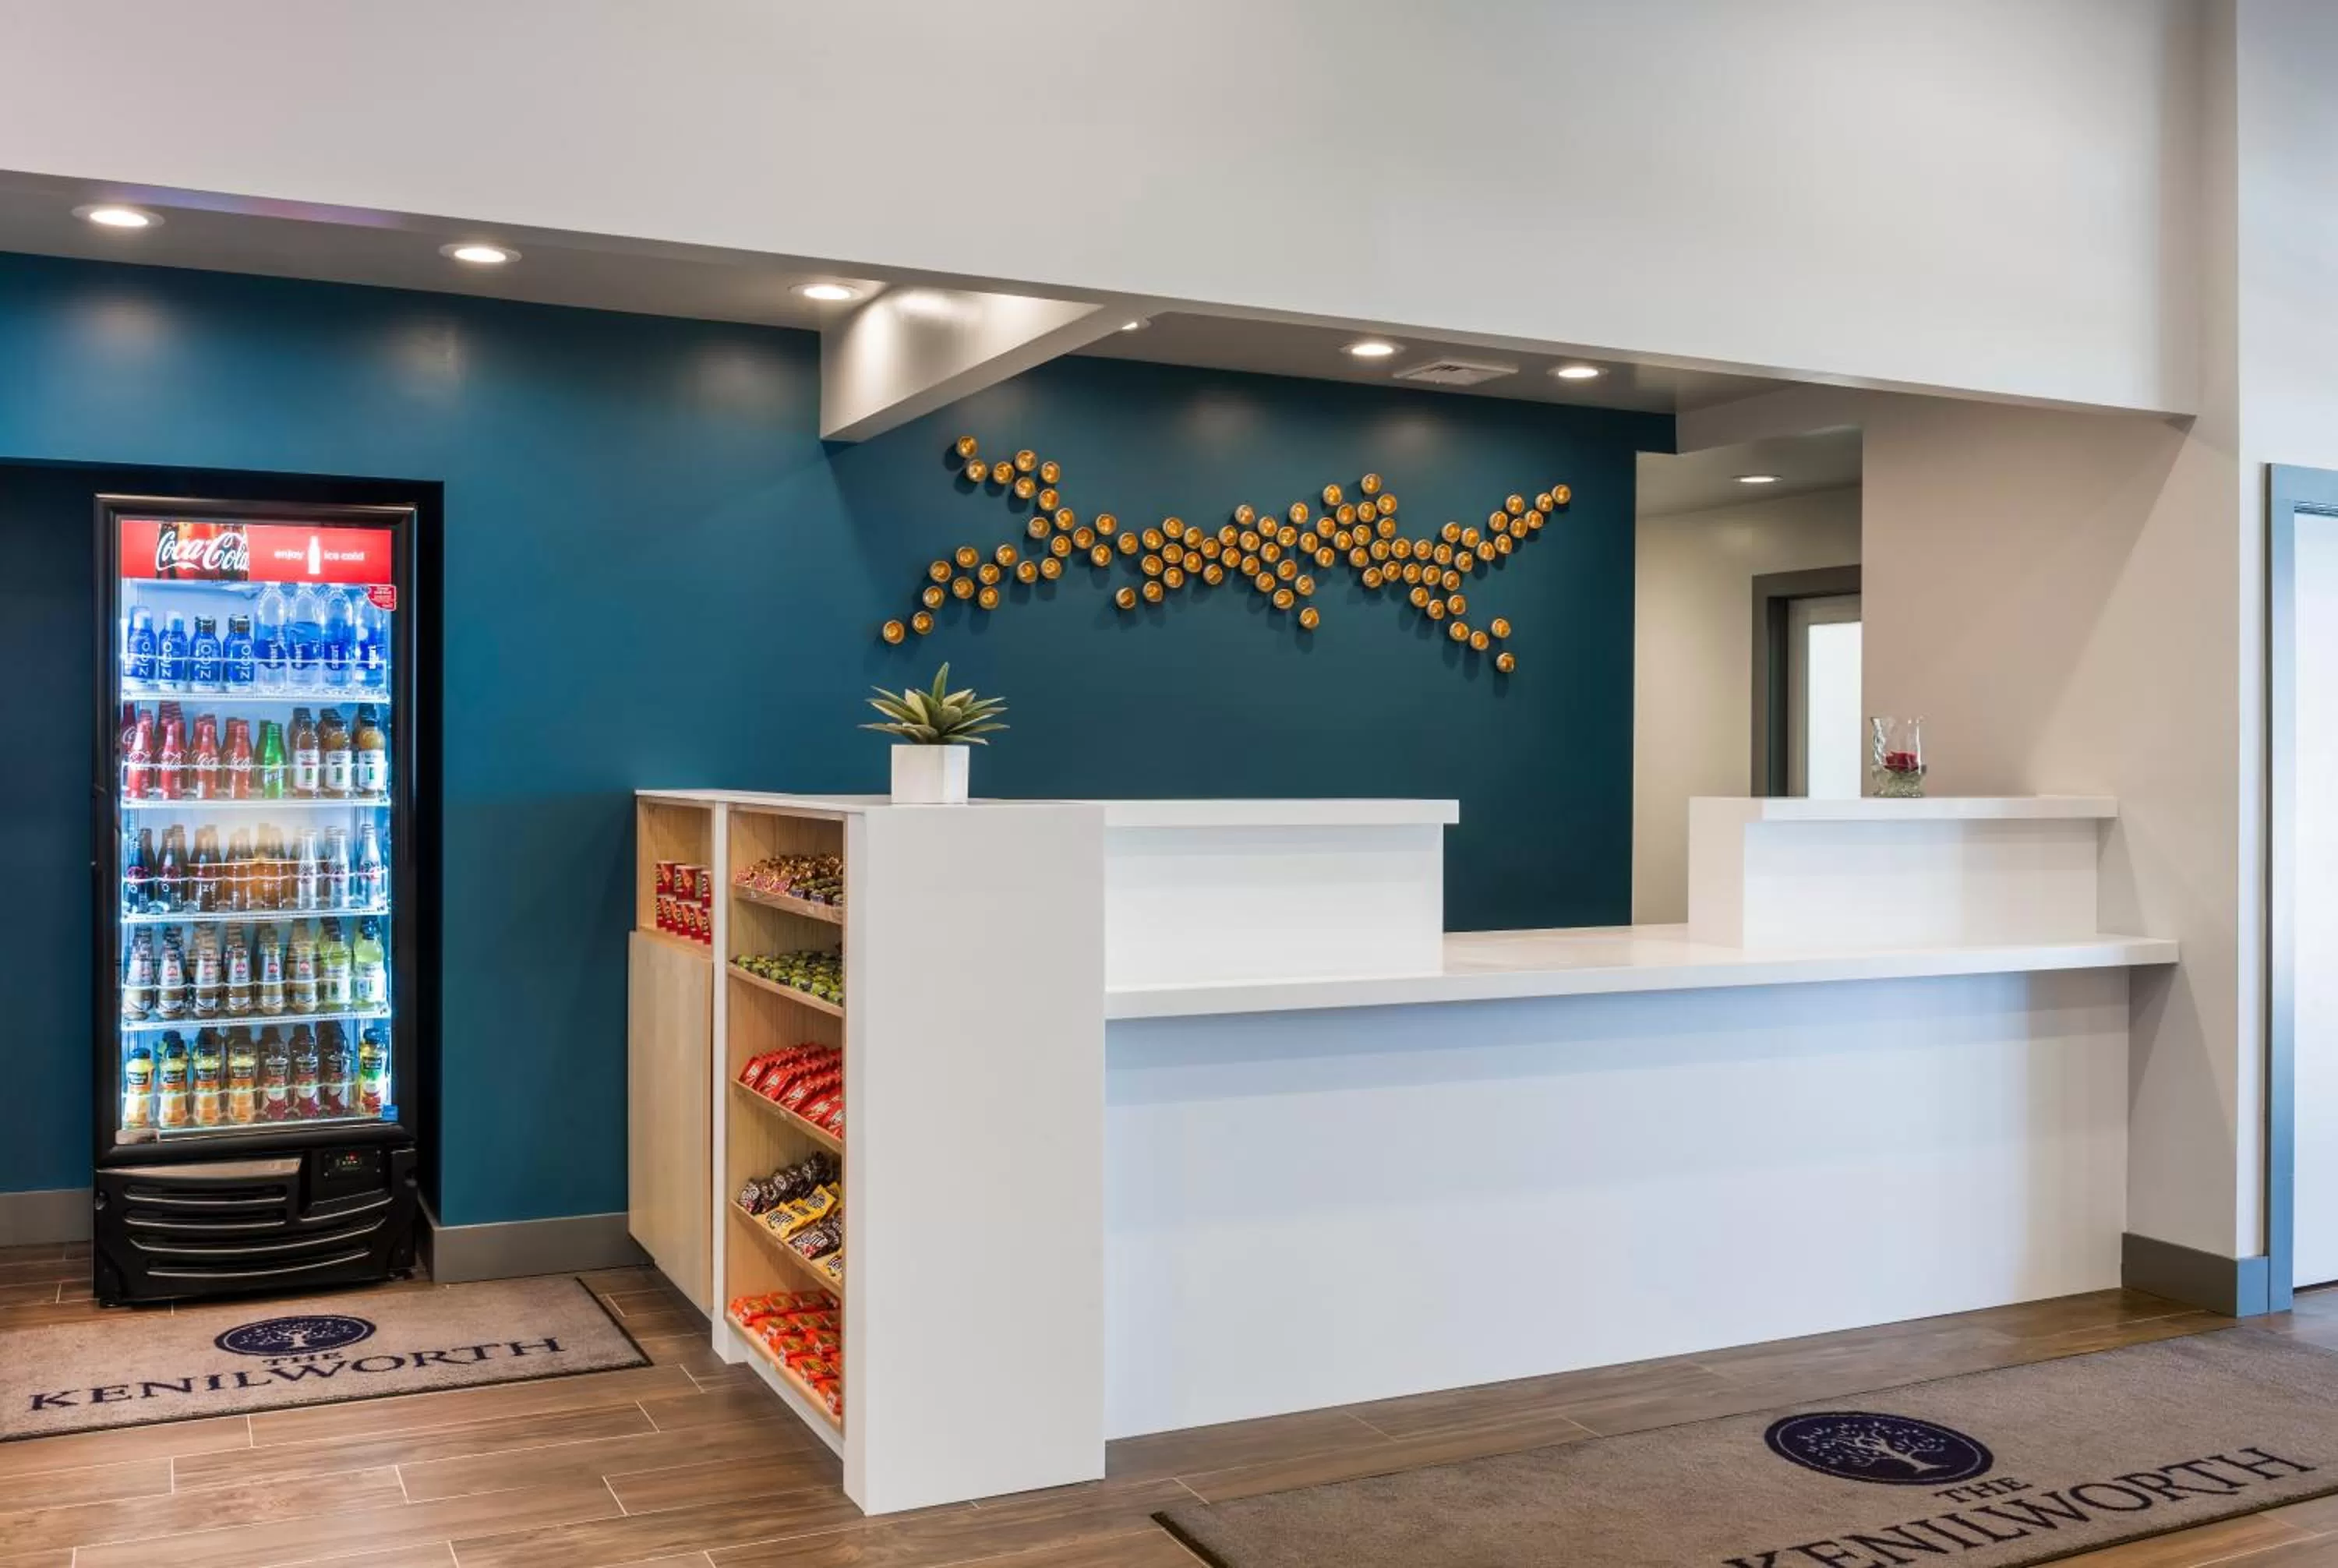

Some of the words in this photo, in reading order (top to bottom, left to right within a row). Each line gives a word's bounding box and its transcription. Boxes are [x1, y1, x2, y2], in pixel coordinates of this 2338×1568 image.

[155, 531, 249, 570] Coca-Cola
[274, 549, 304, 560] enjoy
[323, 550, 339, 560] ice
[341, 551, 365, 561] cold
[262, 1351, 343, 1367] THE
[27, 1337, 567, 1412] KENILWORTH
[1933, 1477, 2033, 1503] THE
